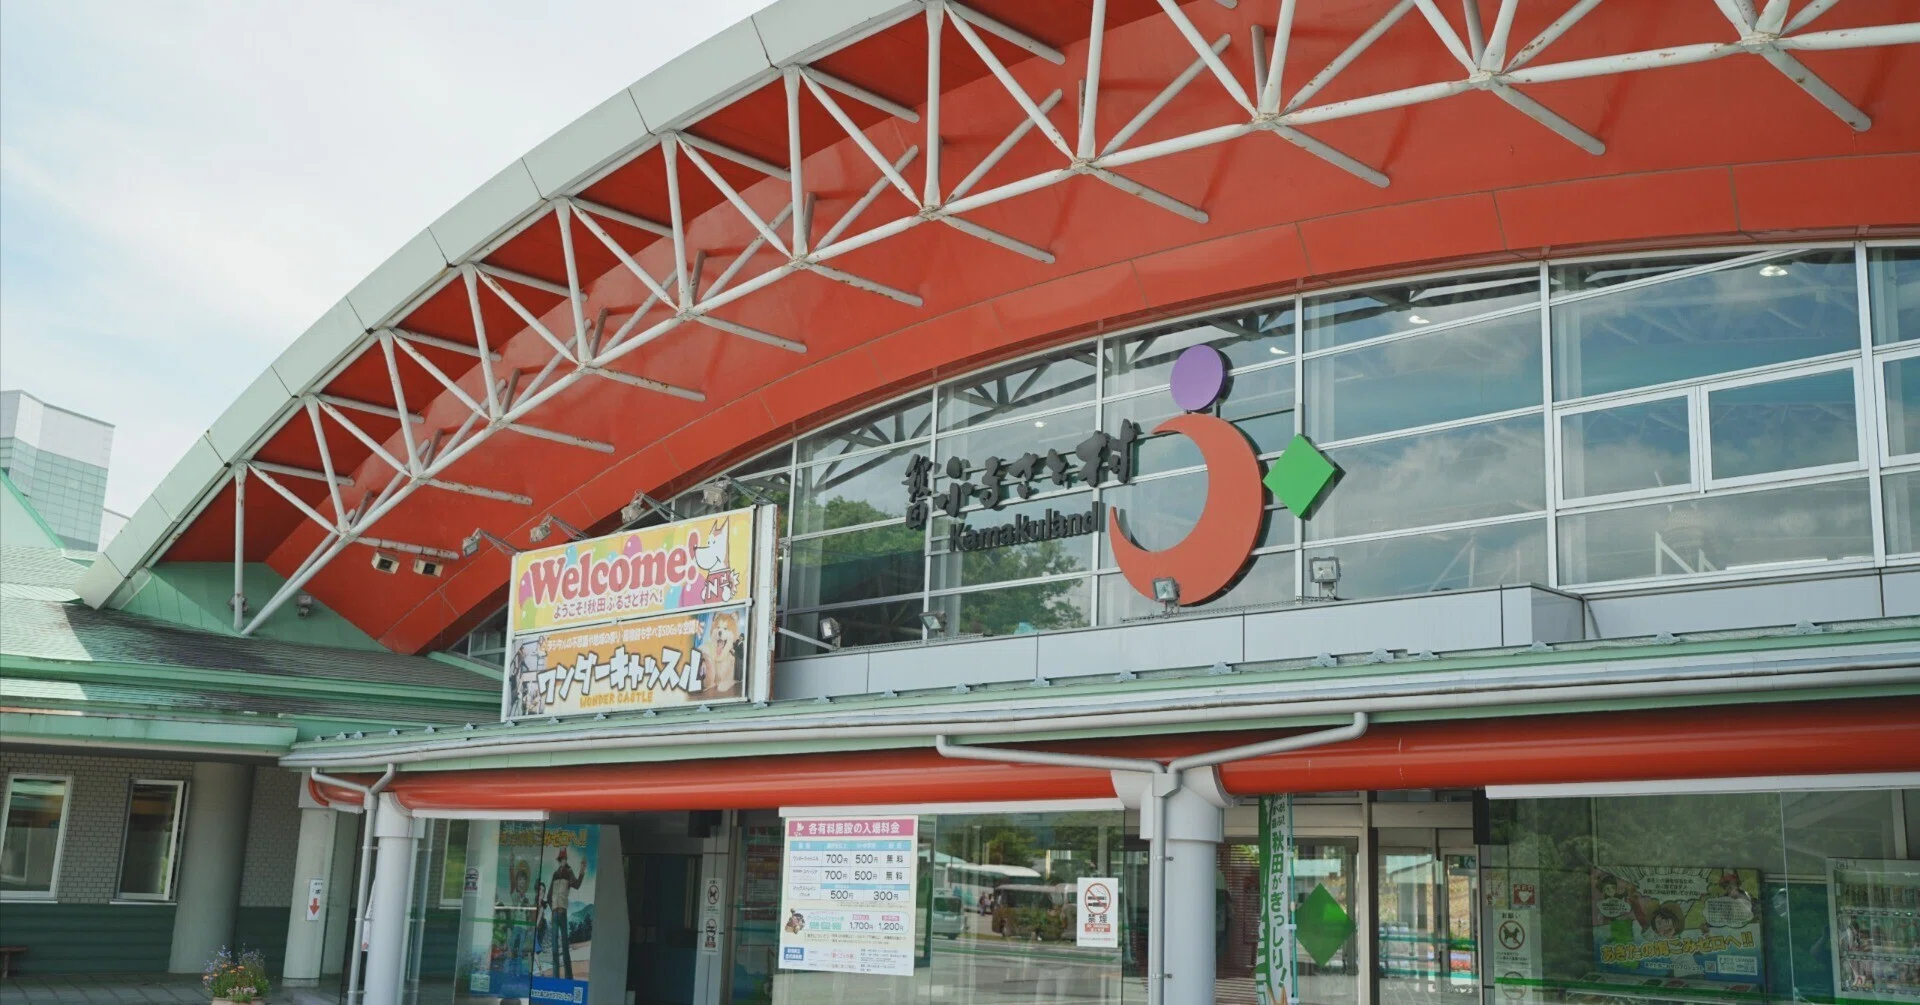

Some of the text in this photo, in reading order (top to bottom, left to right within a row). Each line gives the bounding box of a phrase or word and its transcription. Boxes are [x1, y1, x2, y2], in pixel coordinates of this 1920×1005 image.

[951, 500, 1101, 552] Kamakuland
[529, 531, 700, 605] Welcome!
[538, 645, 703, 705] ワンダーキャッスル
[580, 691, 654, 708] WONDER CASTLE
[808, 822, 900, 835] 各有料施設の入場料金
[826, 854, 848, 864] 700円
[855, 854, 878, 864] 500円
[886, 854, 904, 863] 無料
[825, 870, 847, 880] 700円
[854, 871, 878, 881] 500円
[886, 871, 903, 880] 無料
[830, 890, 899, 901] 500円 300円
